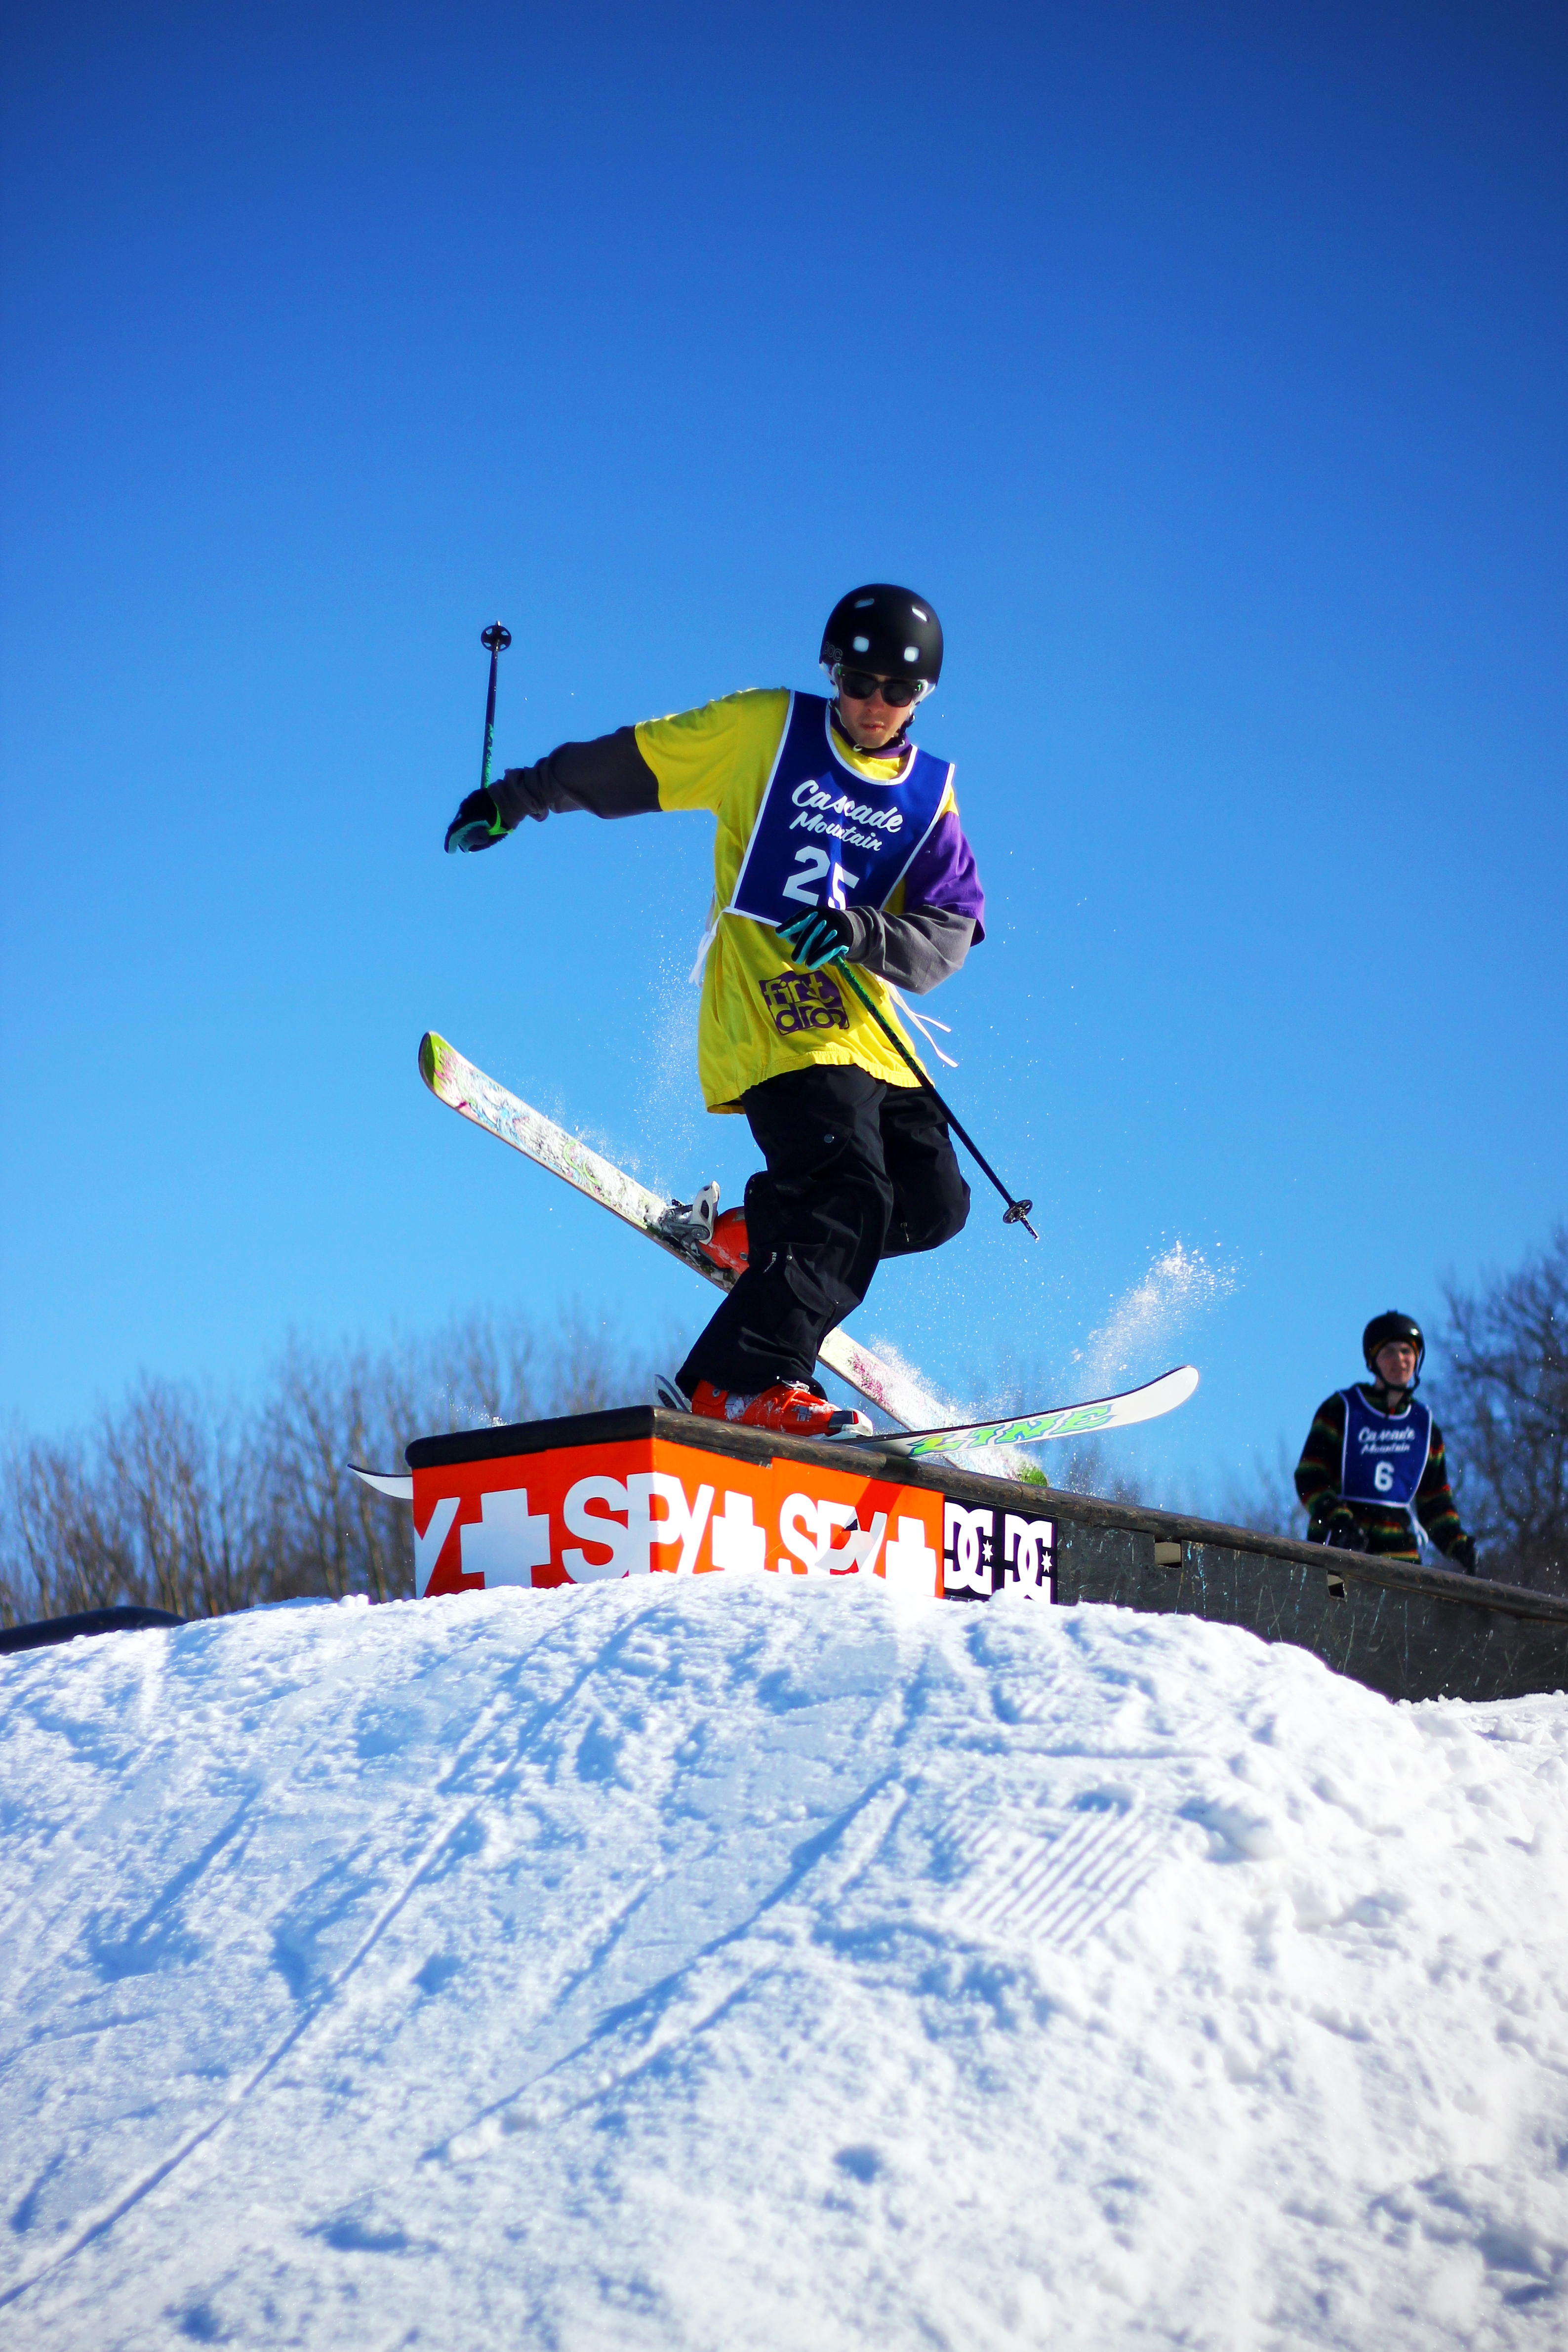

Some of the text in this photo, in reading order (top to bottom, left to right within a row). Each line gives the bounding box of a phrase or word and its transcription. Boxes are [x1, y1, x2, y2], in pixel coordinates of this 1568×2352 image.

[789, 810, 883, 851] Mountain
[791, 779, 903, 833] Cascade
[782, 845, 860, 910] 25
[907, 1403, 1118, 1456] LINE
[1374, 1461, 1395, 1492] 6
